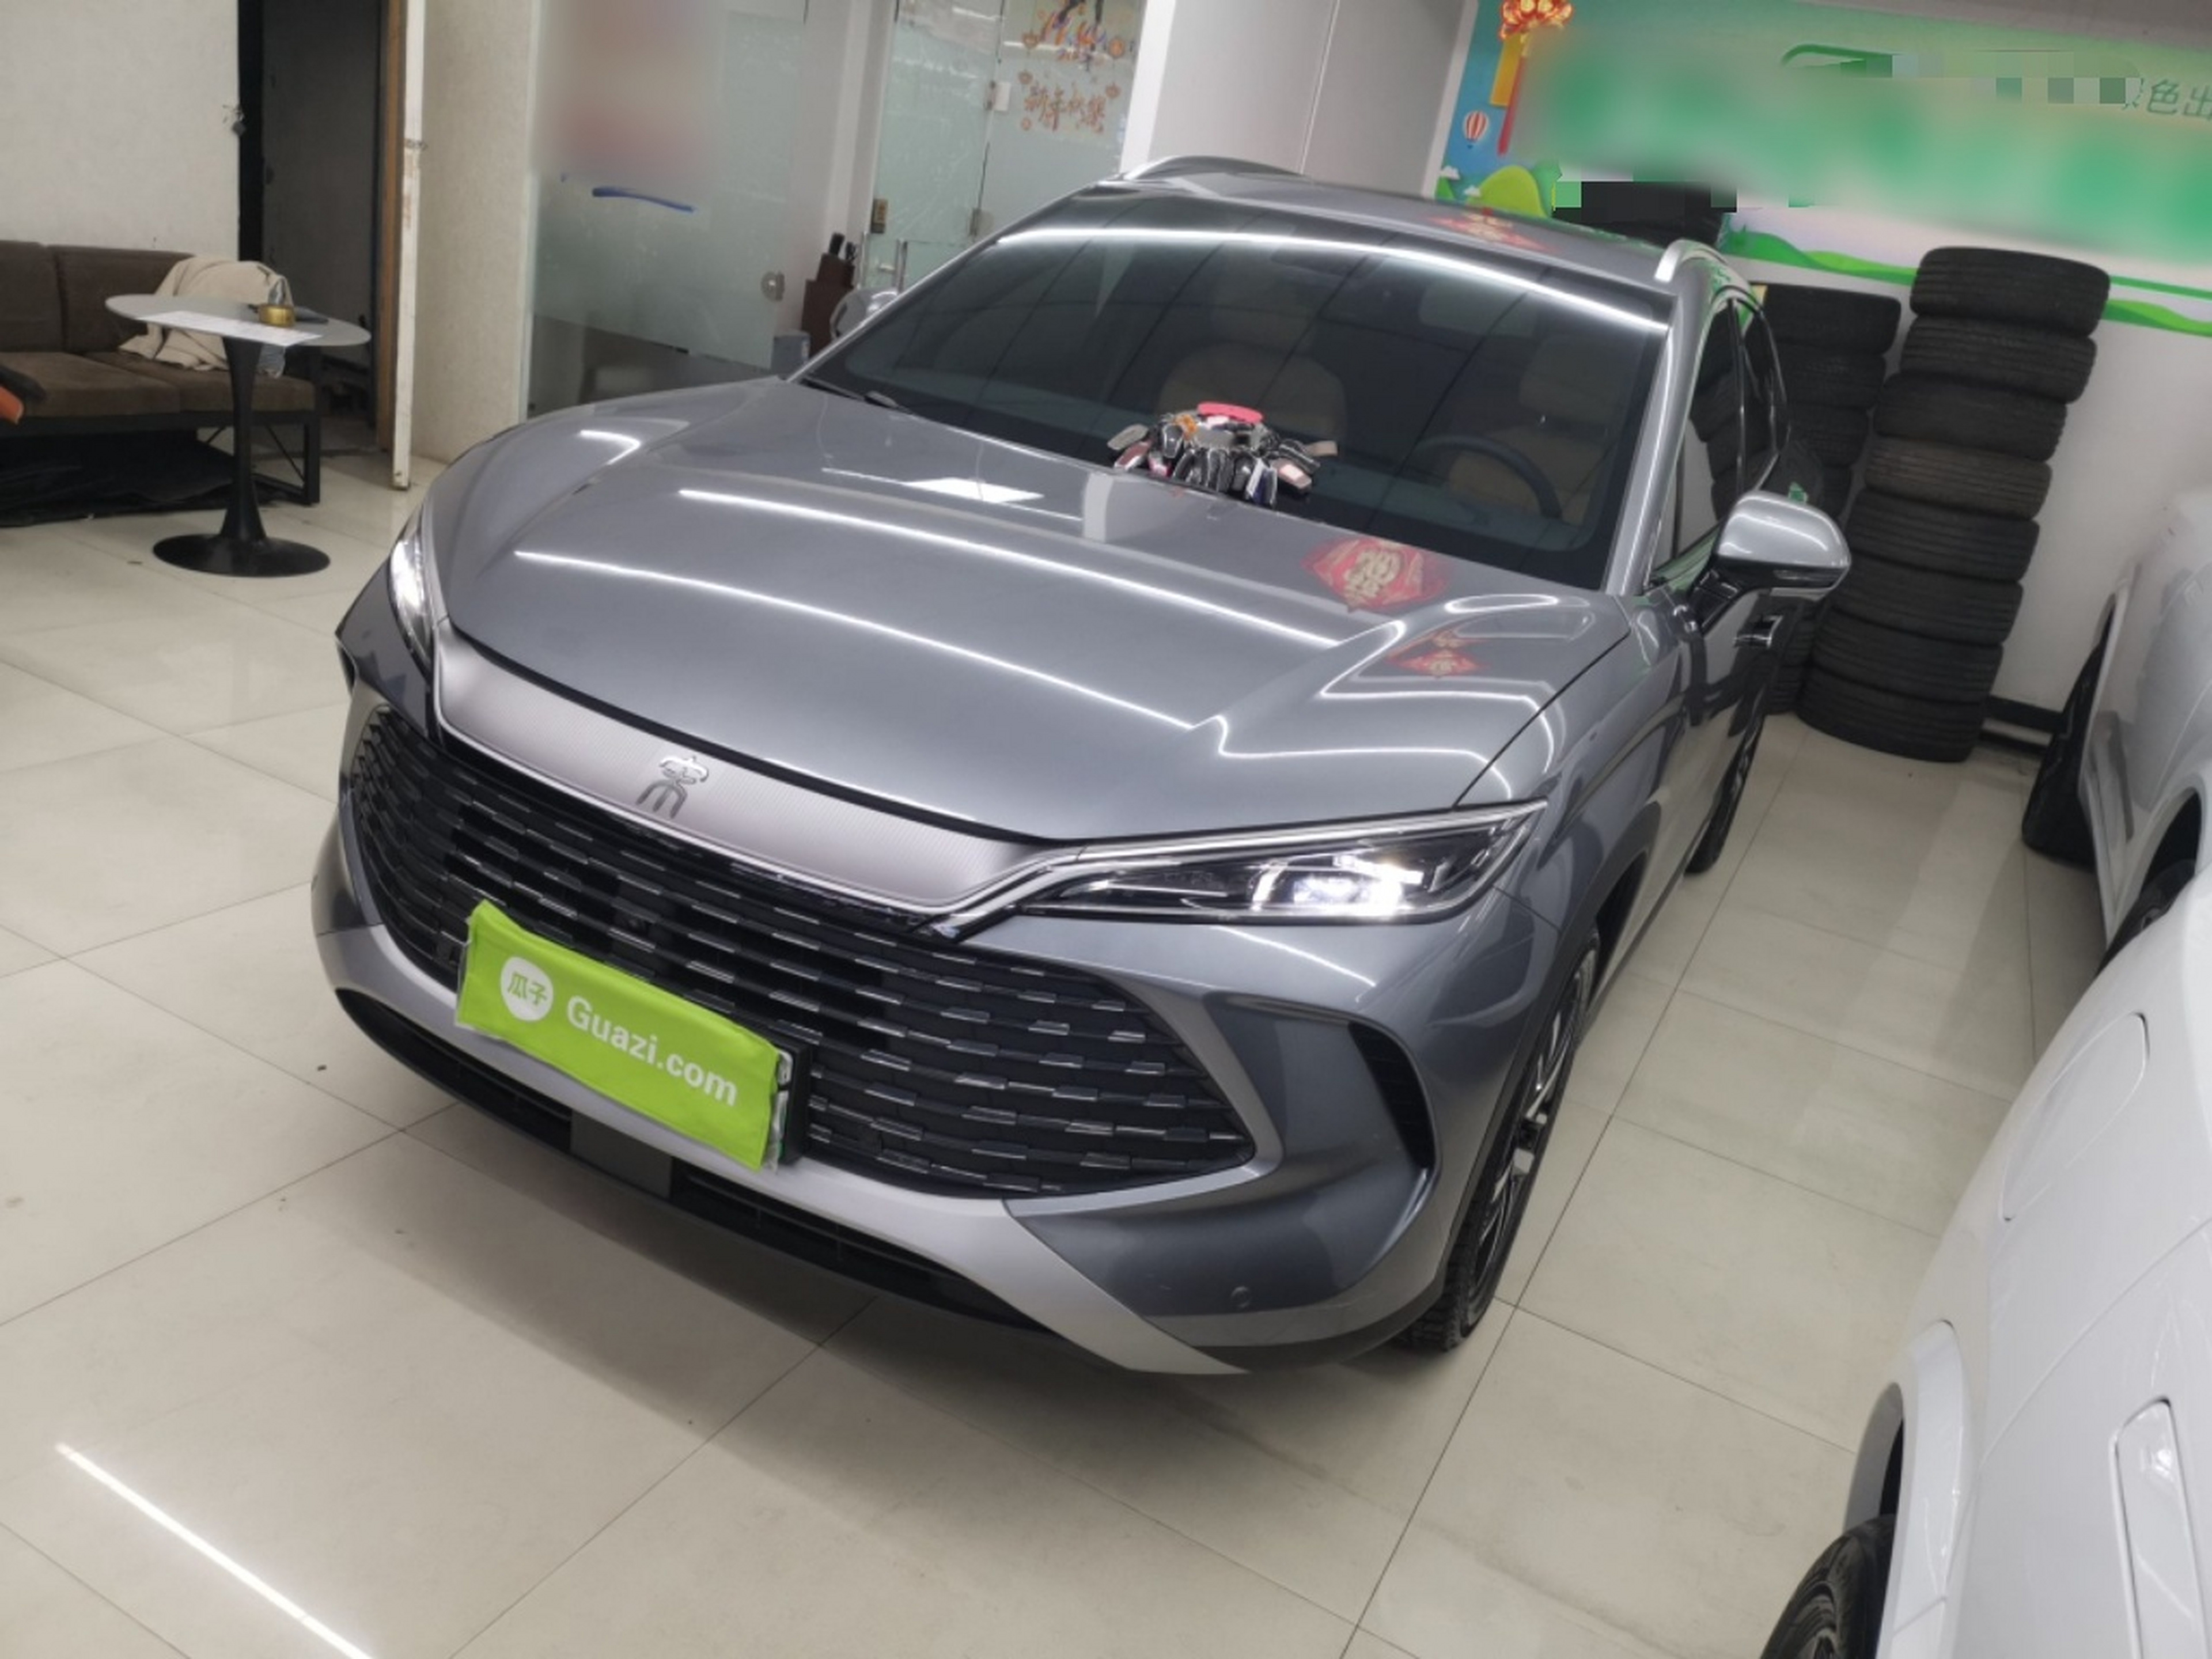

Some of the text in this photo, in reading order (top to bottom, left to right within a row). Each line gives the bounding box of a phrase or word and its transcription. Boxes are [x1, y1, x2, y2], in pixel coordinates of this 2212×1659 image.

[2123, 77, 2212, 120] 色出
[507, 972, 737, 1107] 瓜子 Guazi.com
